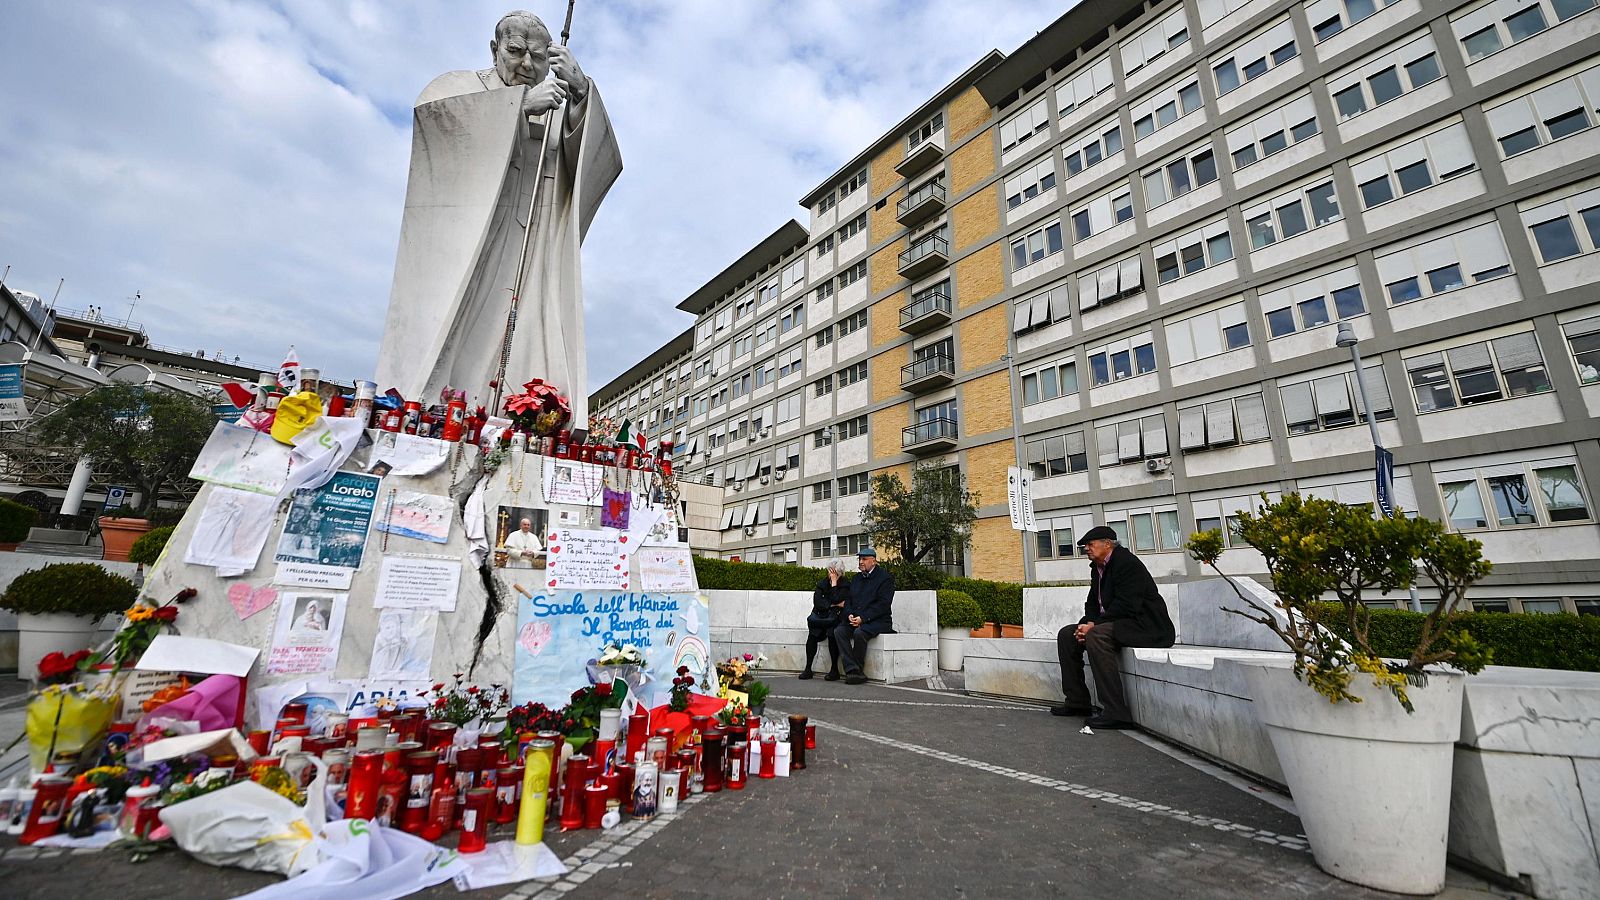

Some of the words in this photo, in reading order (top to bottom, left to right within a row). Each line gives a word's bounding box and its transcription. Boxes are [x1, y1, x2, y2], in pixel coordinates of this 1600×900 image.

[332, 483, 374, 498] Loreto
[335, 476, 376, 489] cerata
[1010, 490, 1019, 524] Gemelli
[582, 616, 600, 636] Il
[655, 613, 675, 628] dei
